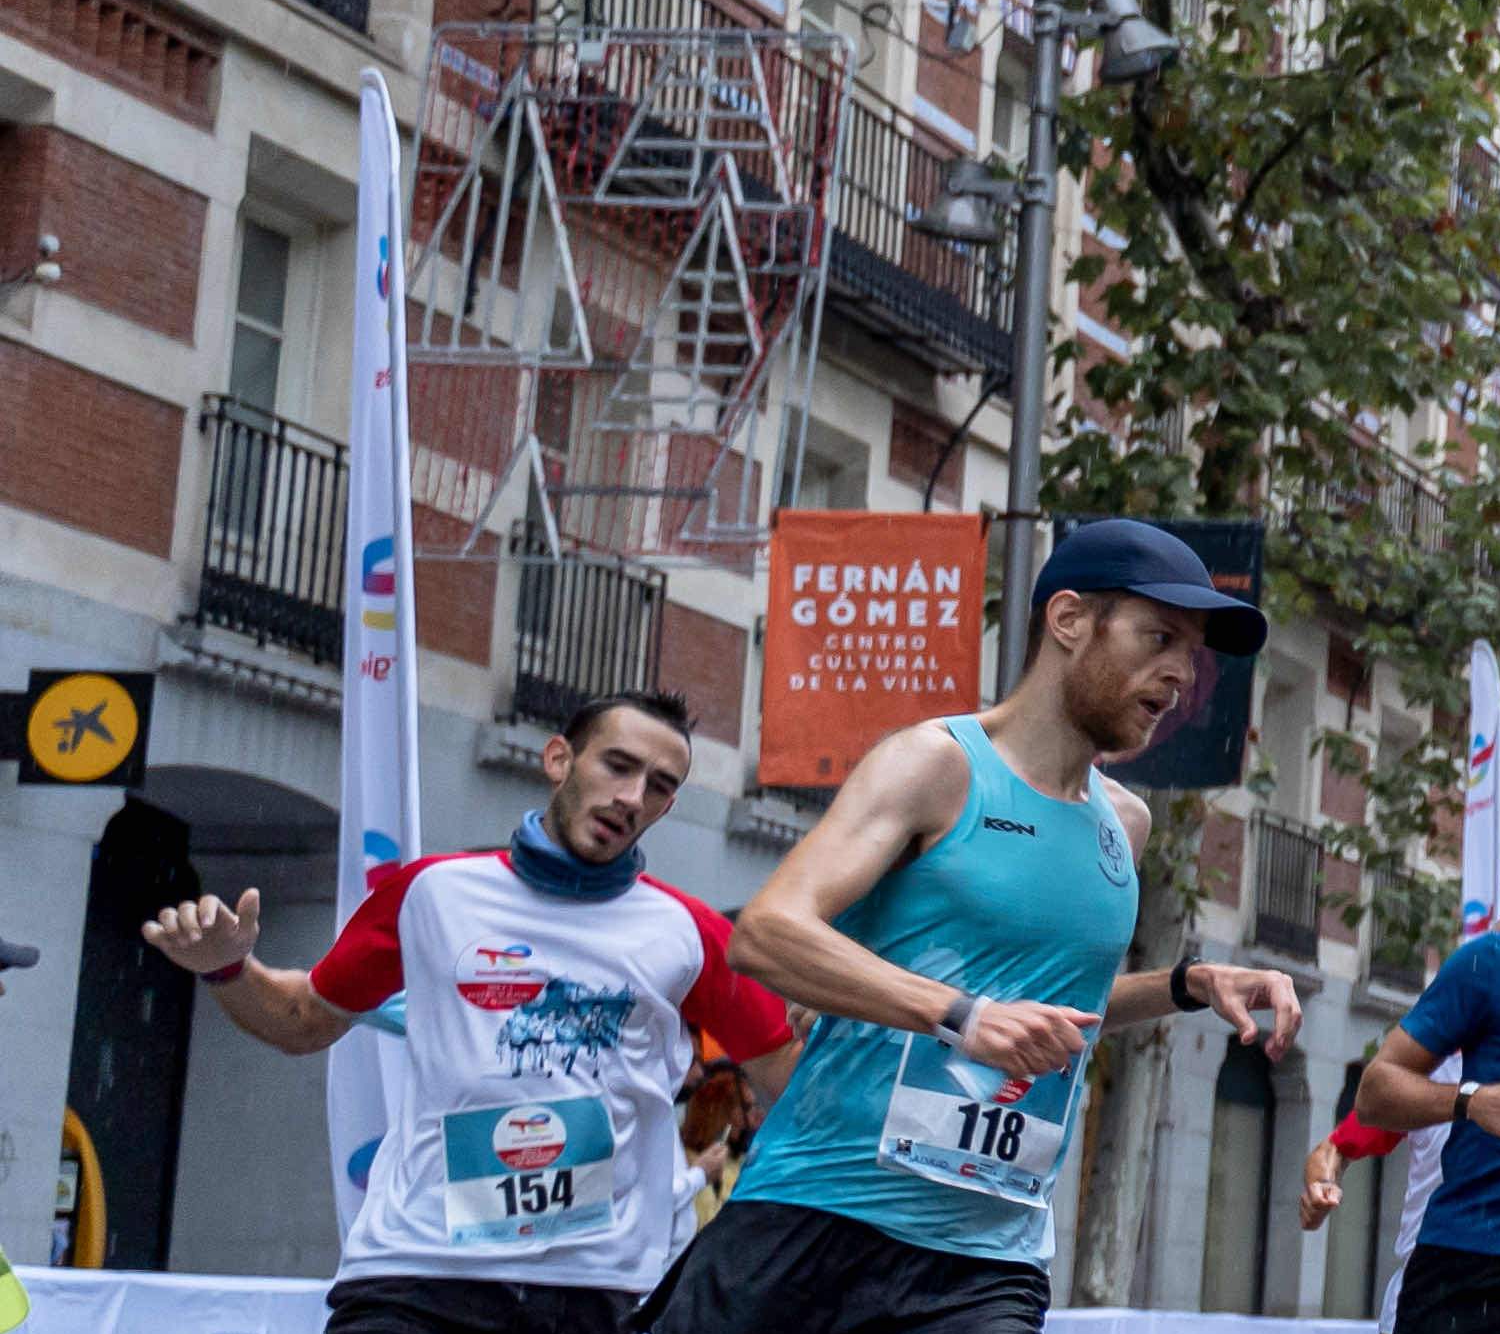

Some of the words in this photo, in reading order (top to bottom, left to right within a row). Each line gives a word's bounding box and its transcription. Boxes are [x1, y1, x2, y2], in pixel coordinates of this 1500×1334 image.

[793, 558, 961, 593] FERNÁN
[791, 591, 960, 627] GÓMEZ
[825, 634, 926, 651] CENTRO
[808, 654, 939, 672] CULTURAL
[789, 675, 821, 691] DE
[836, 675, 867, 692] LA
[883, 675, 956, 692] VILLA
[957, 1103, 1026, 1162] 118
[495, 1168, 575, 1218] 154
